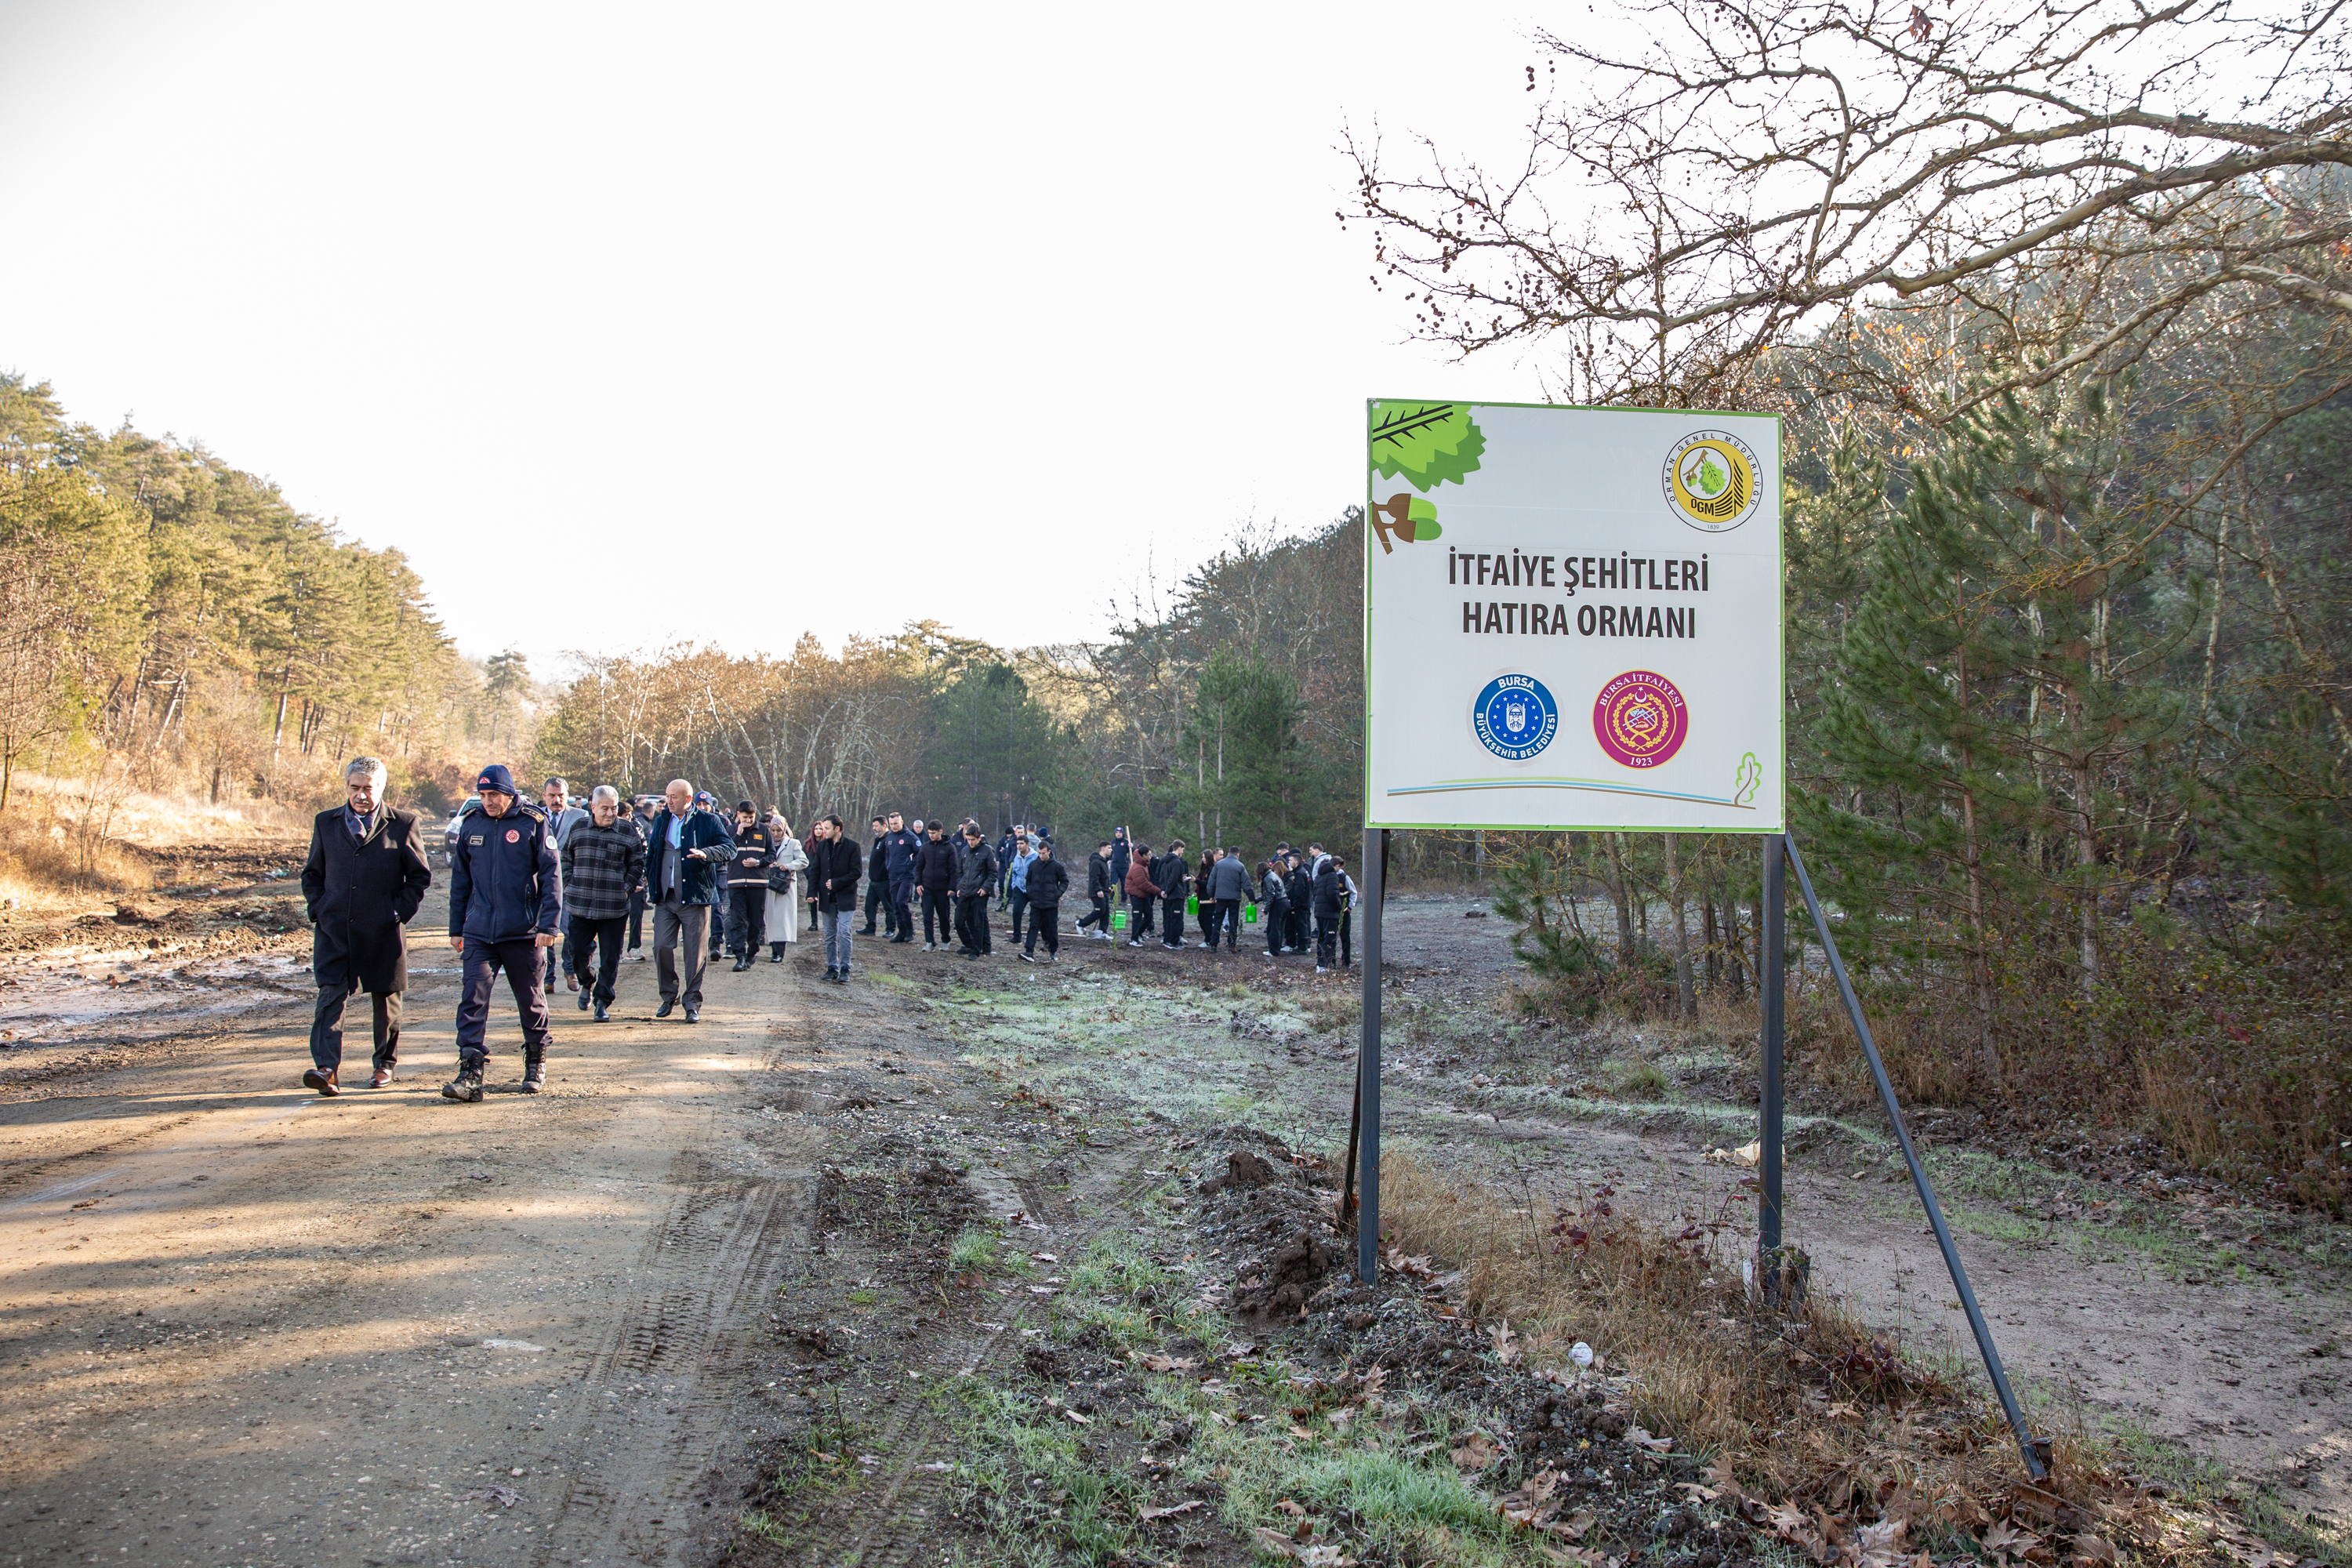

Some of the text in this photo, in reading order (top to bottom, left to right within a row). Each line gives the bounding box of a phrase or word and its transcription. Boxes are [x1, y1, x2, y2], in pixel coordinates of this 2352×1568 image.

[1665, 433, 1762, 506] ORMAN GENEL MÜDÜRLÜĞÜ
[1690, 498, 1715, 516] OGM
[1449, 545, 1708, 597] İTFAİYE ŞEHİTLERİ
[1463, 601, 1695, 639] HATIRA ORMANI
[1497, 676, 1534, 690] BURSA
[1599, 673, 1683, 708] BURSA İTFAİYESİ
[1475, 713, 1555, 759] BÜYÜKŞEHİR BELEDİYESİ
[1630, 757, 1653, 766] 1923
